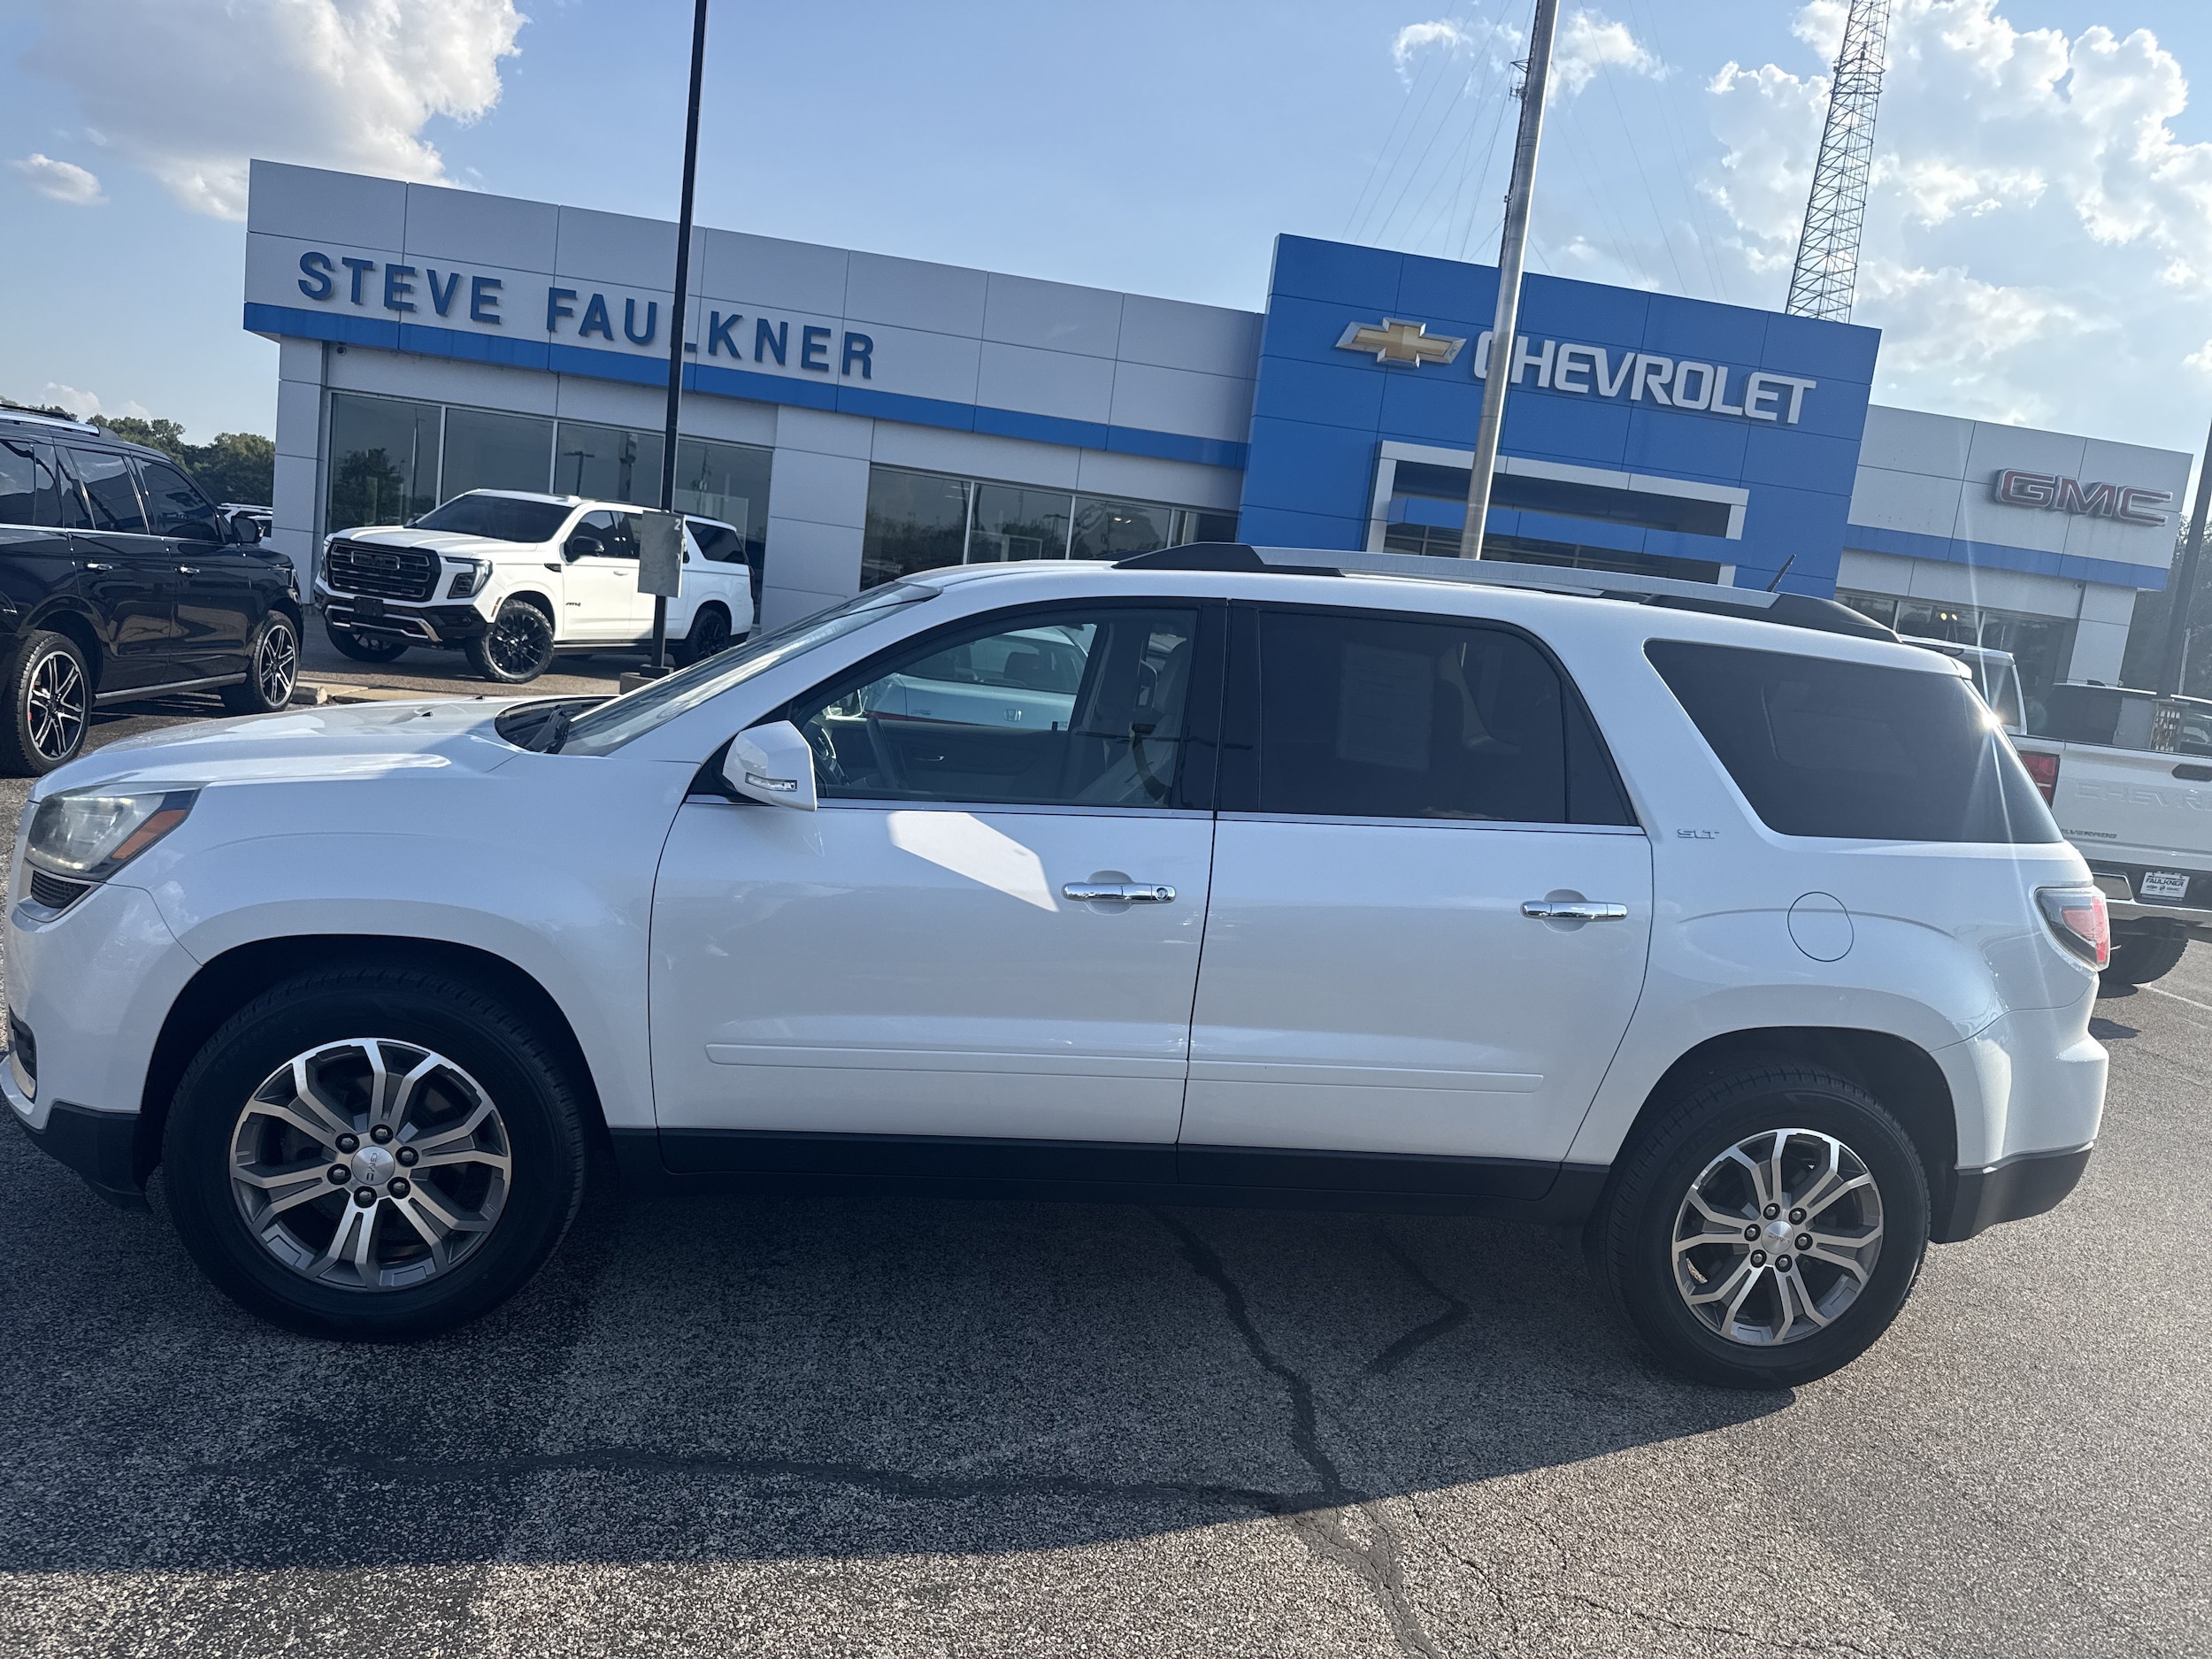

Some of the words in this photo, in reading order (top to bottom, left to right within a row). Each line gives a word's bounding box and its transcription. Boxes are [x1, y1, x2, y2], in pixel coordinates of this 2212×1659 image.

[297, 251, 503, 324] STEVE
[546, 287, 874, 380] FAUKNER
[1994, 468, 2173, 526] GMC
[673, 518, 681, 531] 2
[1677, 828, 1720, 840] SLT
[366, 1152, 379, 1181] GMC
